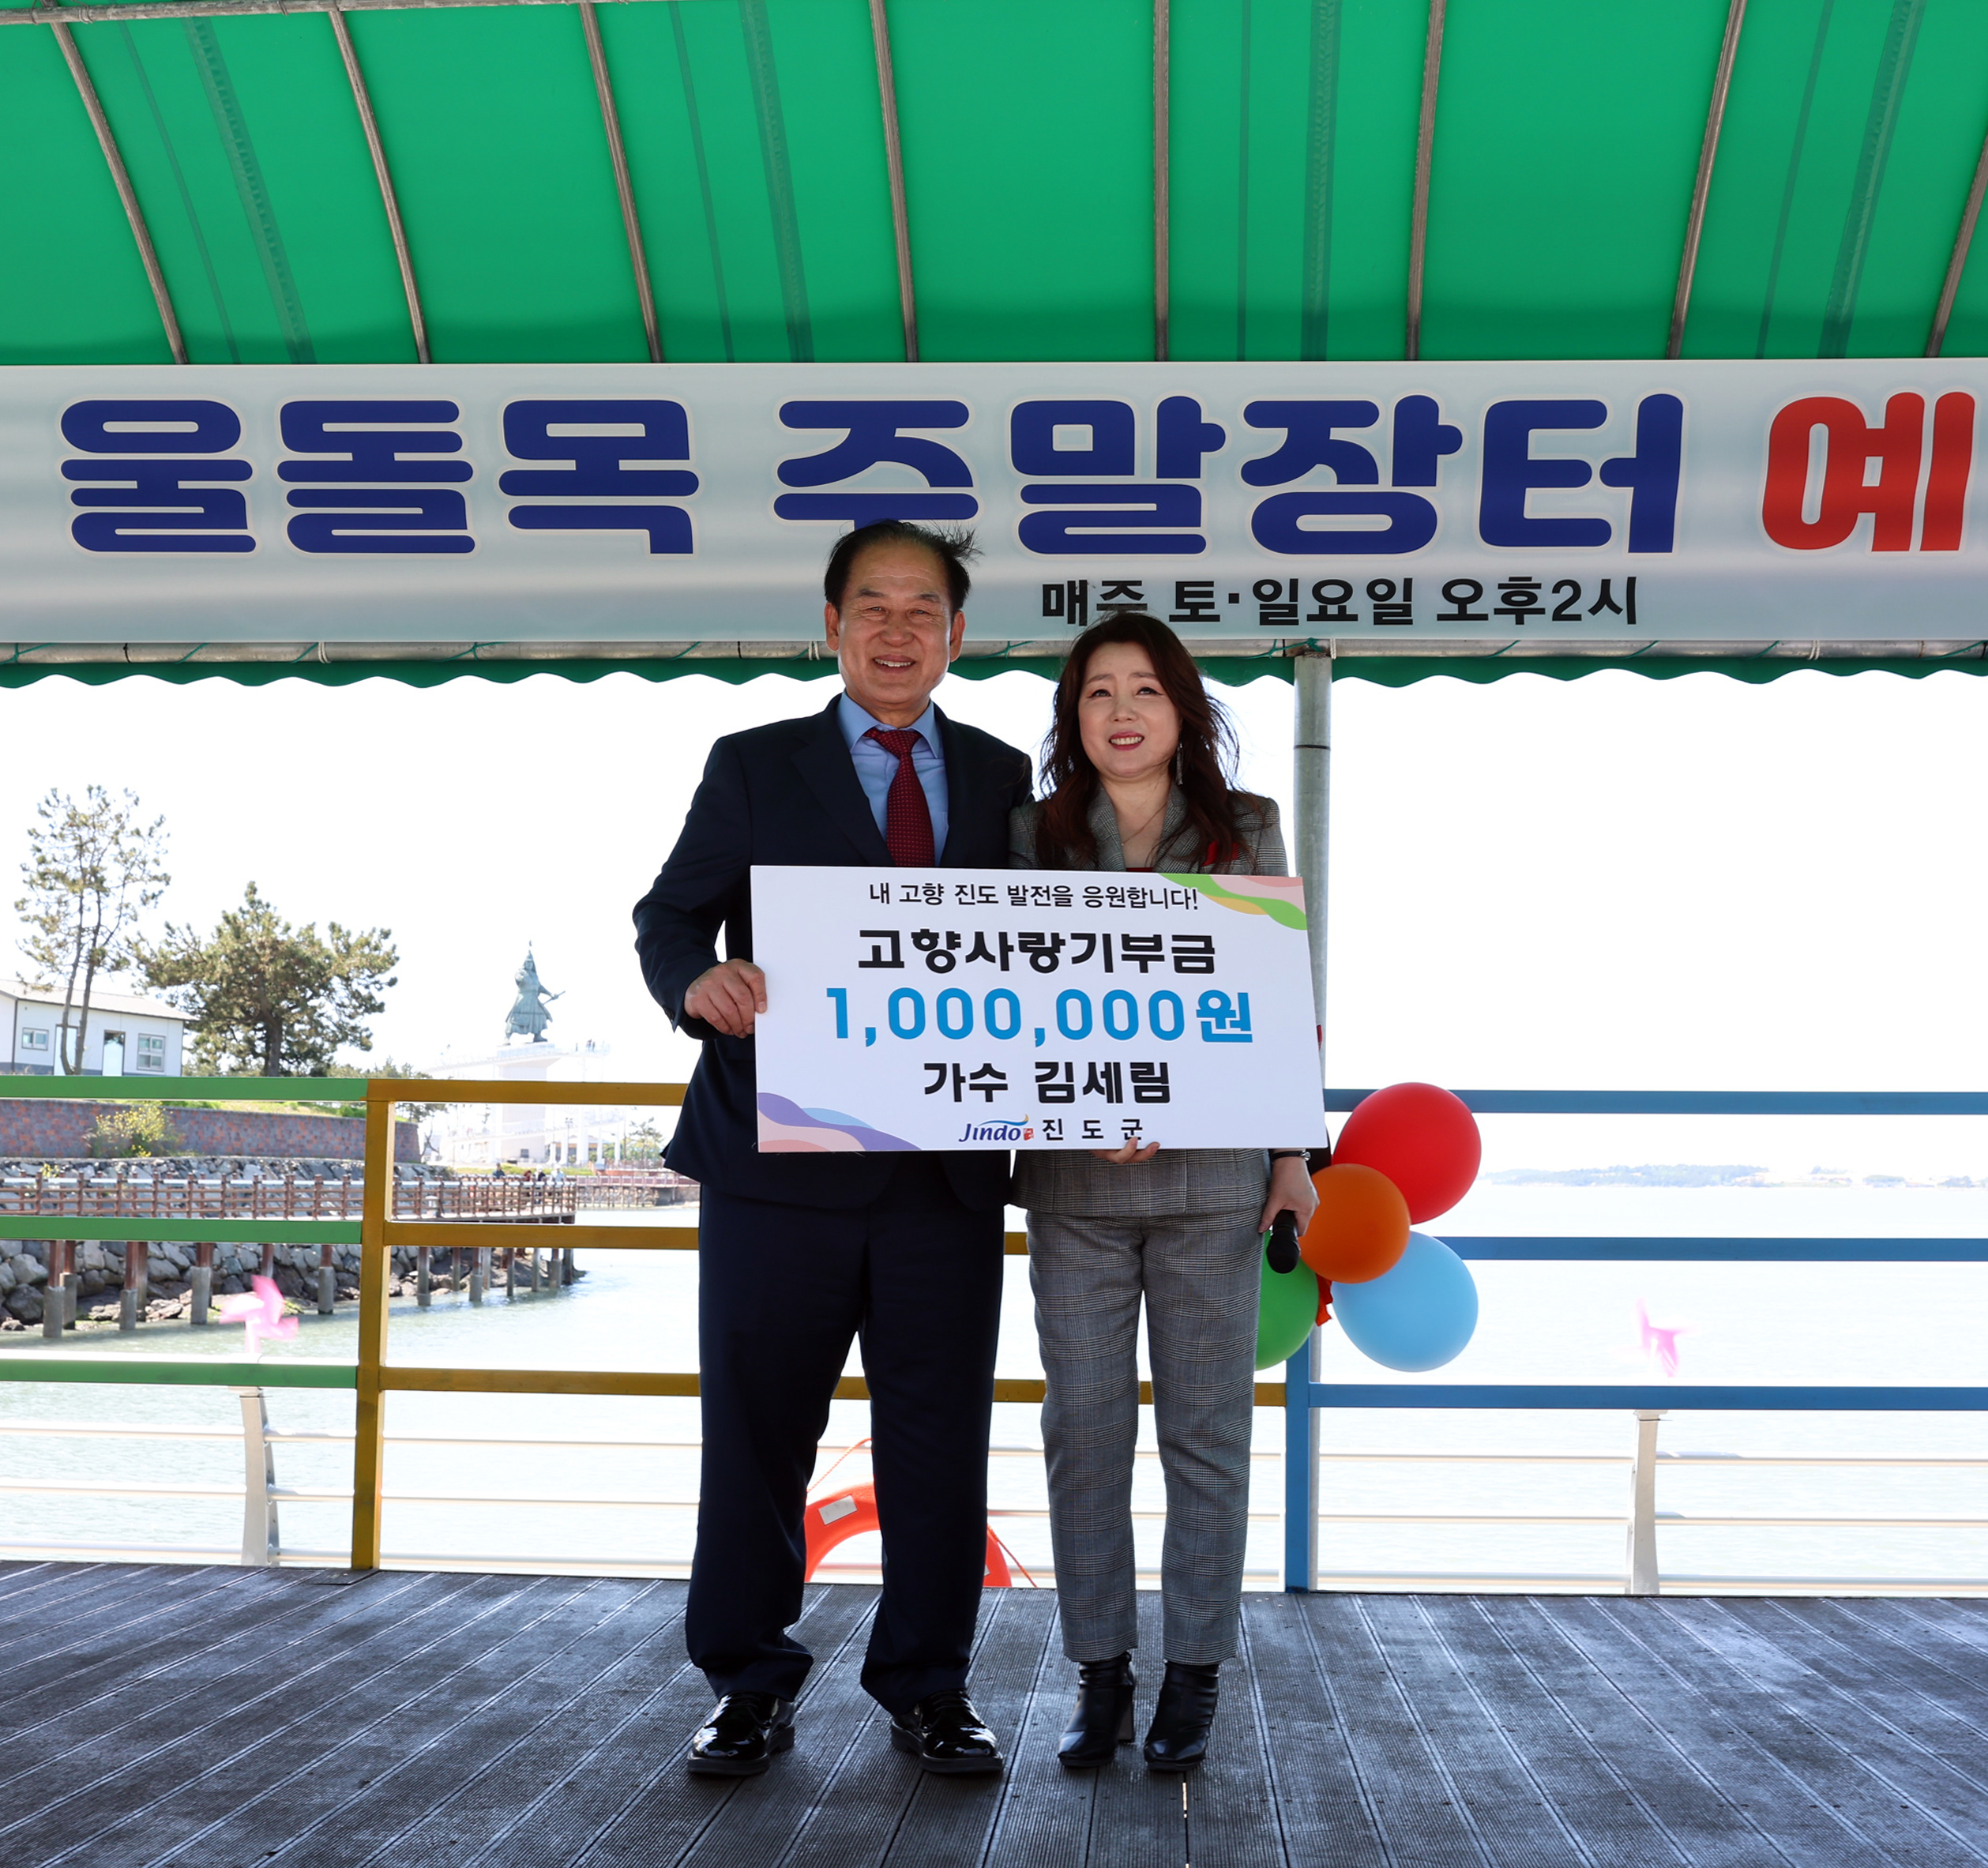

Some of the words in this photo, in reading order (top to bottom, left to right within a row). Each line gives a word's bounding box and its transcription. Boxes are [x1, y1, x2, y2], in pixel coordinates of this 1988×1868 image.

[61, 399, 699, 554] 울돌목
[773, 393, 1684, 555] 주말장터
[1762, 391, 1976, 552] 예
[1042, 579, 1148, 627] 매주
[1169, 578, 1414, 626] 토·일요일
[1436, 576, 1637, 626] 오후2시
[870, 882, 890, 904] 내
[899, 882, 945, 906] 고향
[954, 884, 999, 905] 진도
[1007, 885, 1073, 908] 발전을
[1082, 885, 1198, 910] 응원합니다!
[858, 928, 1216, 975] 고향사랑기부금
[826, 987, 1253, 1047] 1,000,000원
[923, 1062, 1009, 1103] 가수
[1035, 1062, 1171, 1104] 김세림
[958, 1121, 1021, 1142] Jindo
